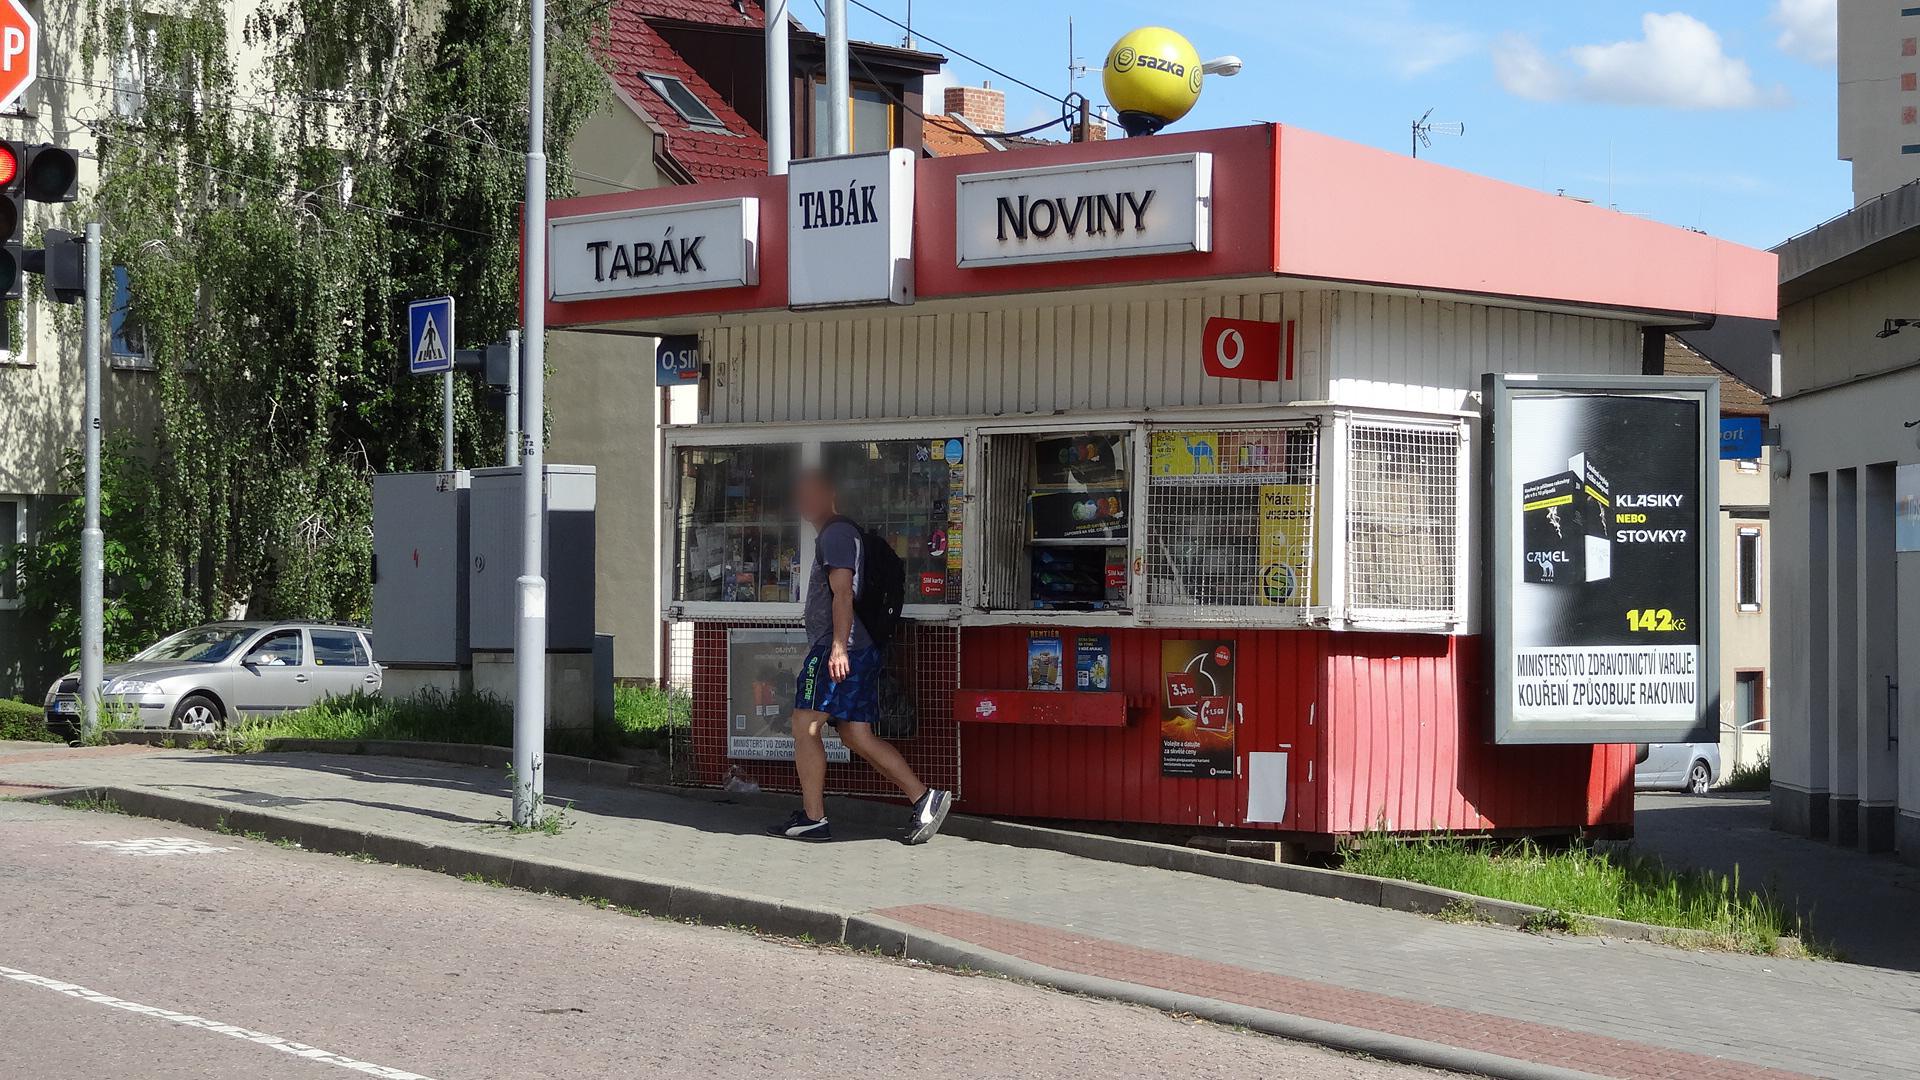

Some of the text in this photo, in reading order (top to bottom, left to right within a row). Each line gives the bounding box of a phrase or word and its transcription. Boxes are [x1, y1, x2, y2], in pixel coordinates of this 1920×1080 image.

[1137, 55, 1185, 78] sazka
[799, 179, 878, 230] TABÁK
[997, 190, 1156, 240] NOVINY
[587, 226, 707, 282] TABÁK
[1616, 494, 1683, 507] KLASIKY
[1616, 514, 1647, 523] NEBO
[1616, 529, 1687, 542] STOVKY?
[1527, 551, 1570, 562] CAMEL
[1517, 648, 1695, 677] MINISTERSTVO ZDRAVOTNICTVÍ VARUJE:
[1518, 677, 1695, 707] KOUŘENÍ ZPŮSOBUJE RAKOVINU
